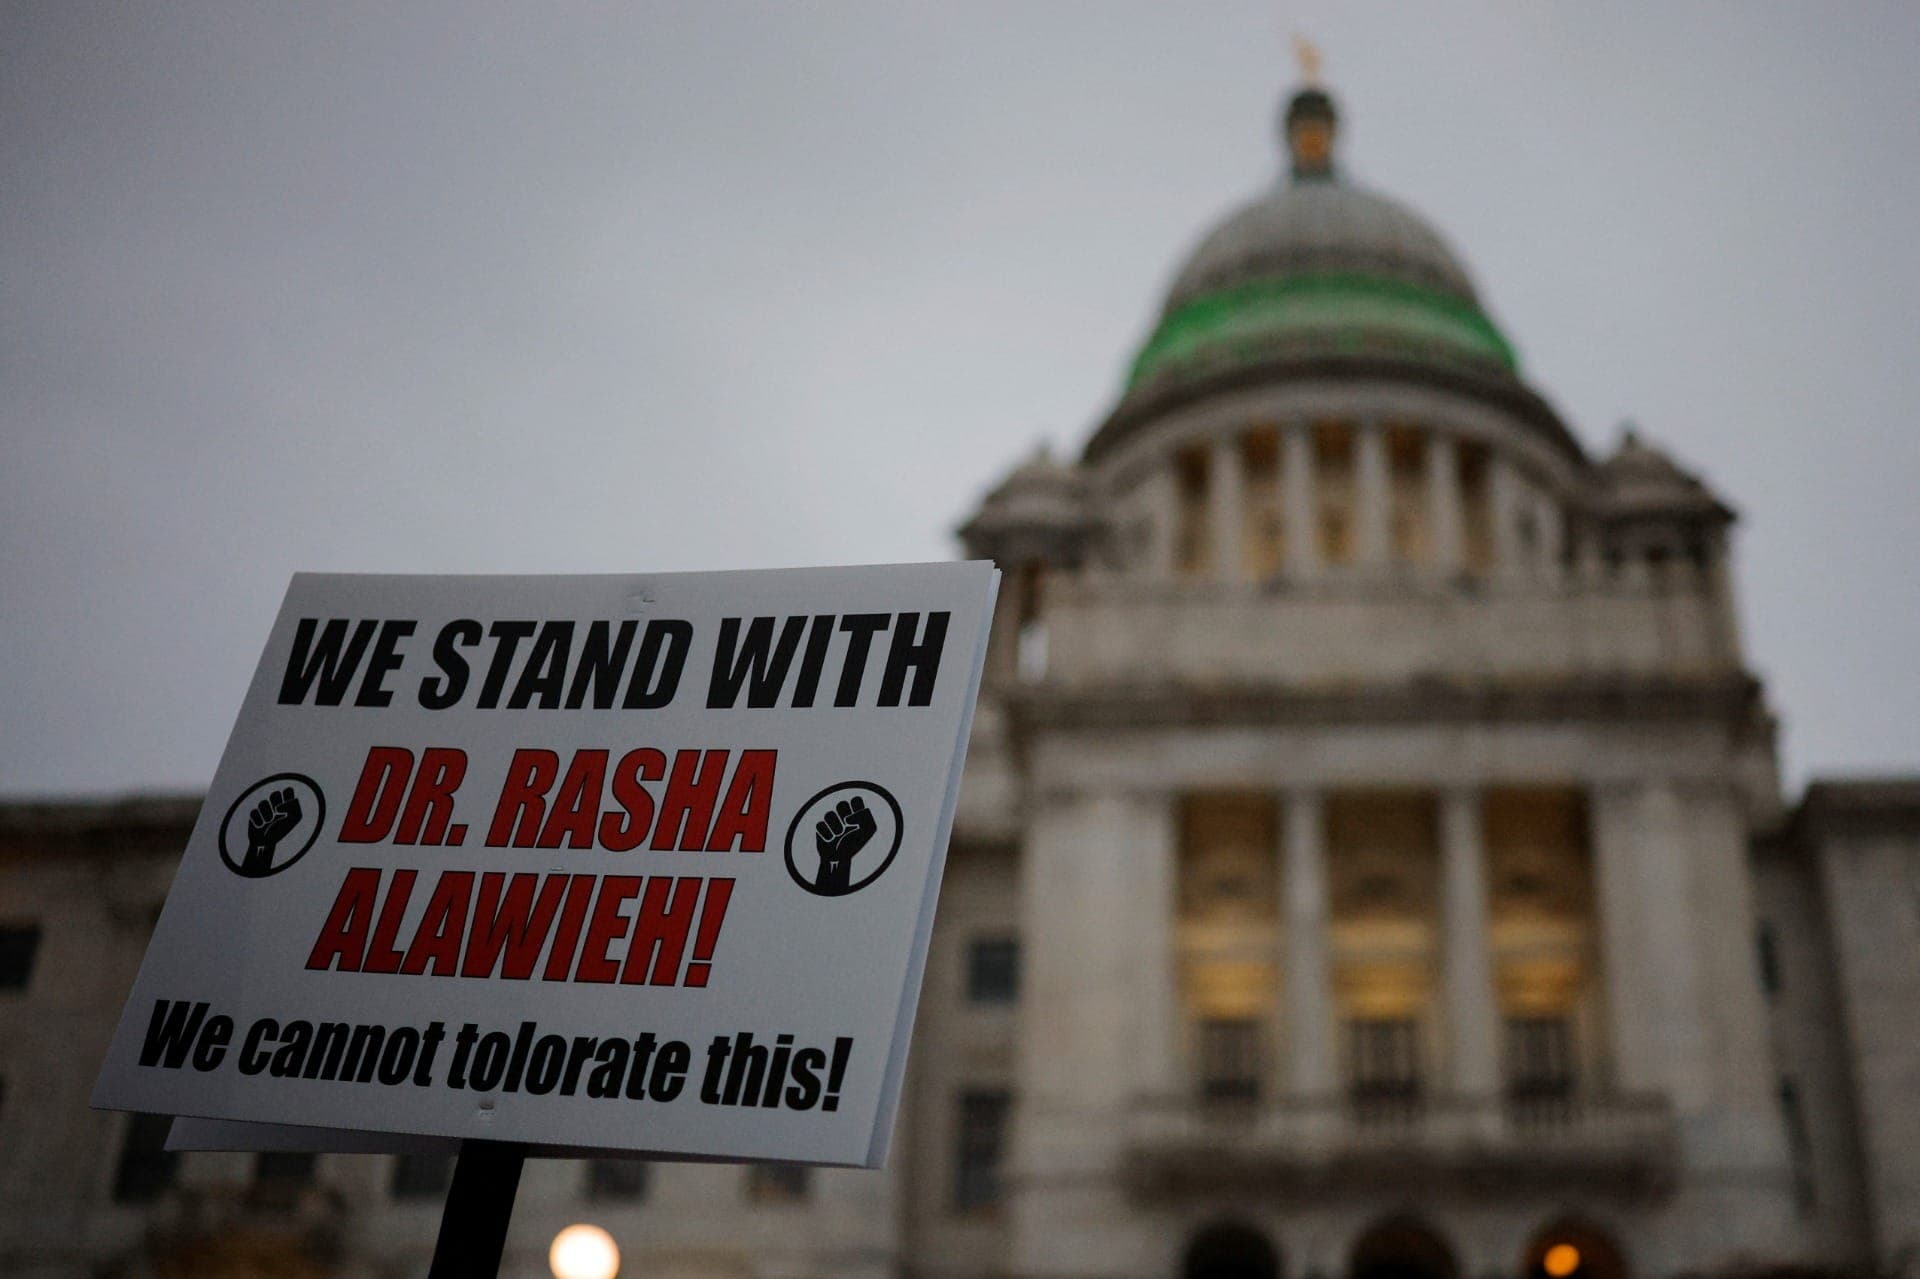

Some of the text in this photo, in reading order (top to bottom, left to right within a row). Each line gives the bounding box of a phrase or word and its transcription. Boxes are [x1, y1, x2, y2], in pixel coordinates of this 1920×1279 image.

[277, 612, 951, 710] WE STAND WITH
[337, 746, 778, 853] DR. RASHA
[304, 867, 736, 988] ALAWIEH!
[138, 1000, 853, 1112] We cannot tolorate this!
